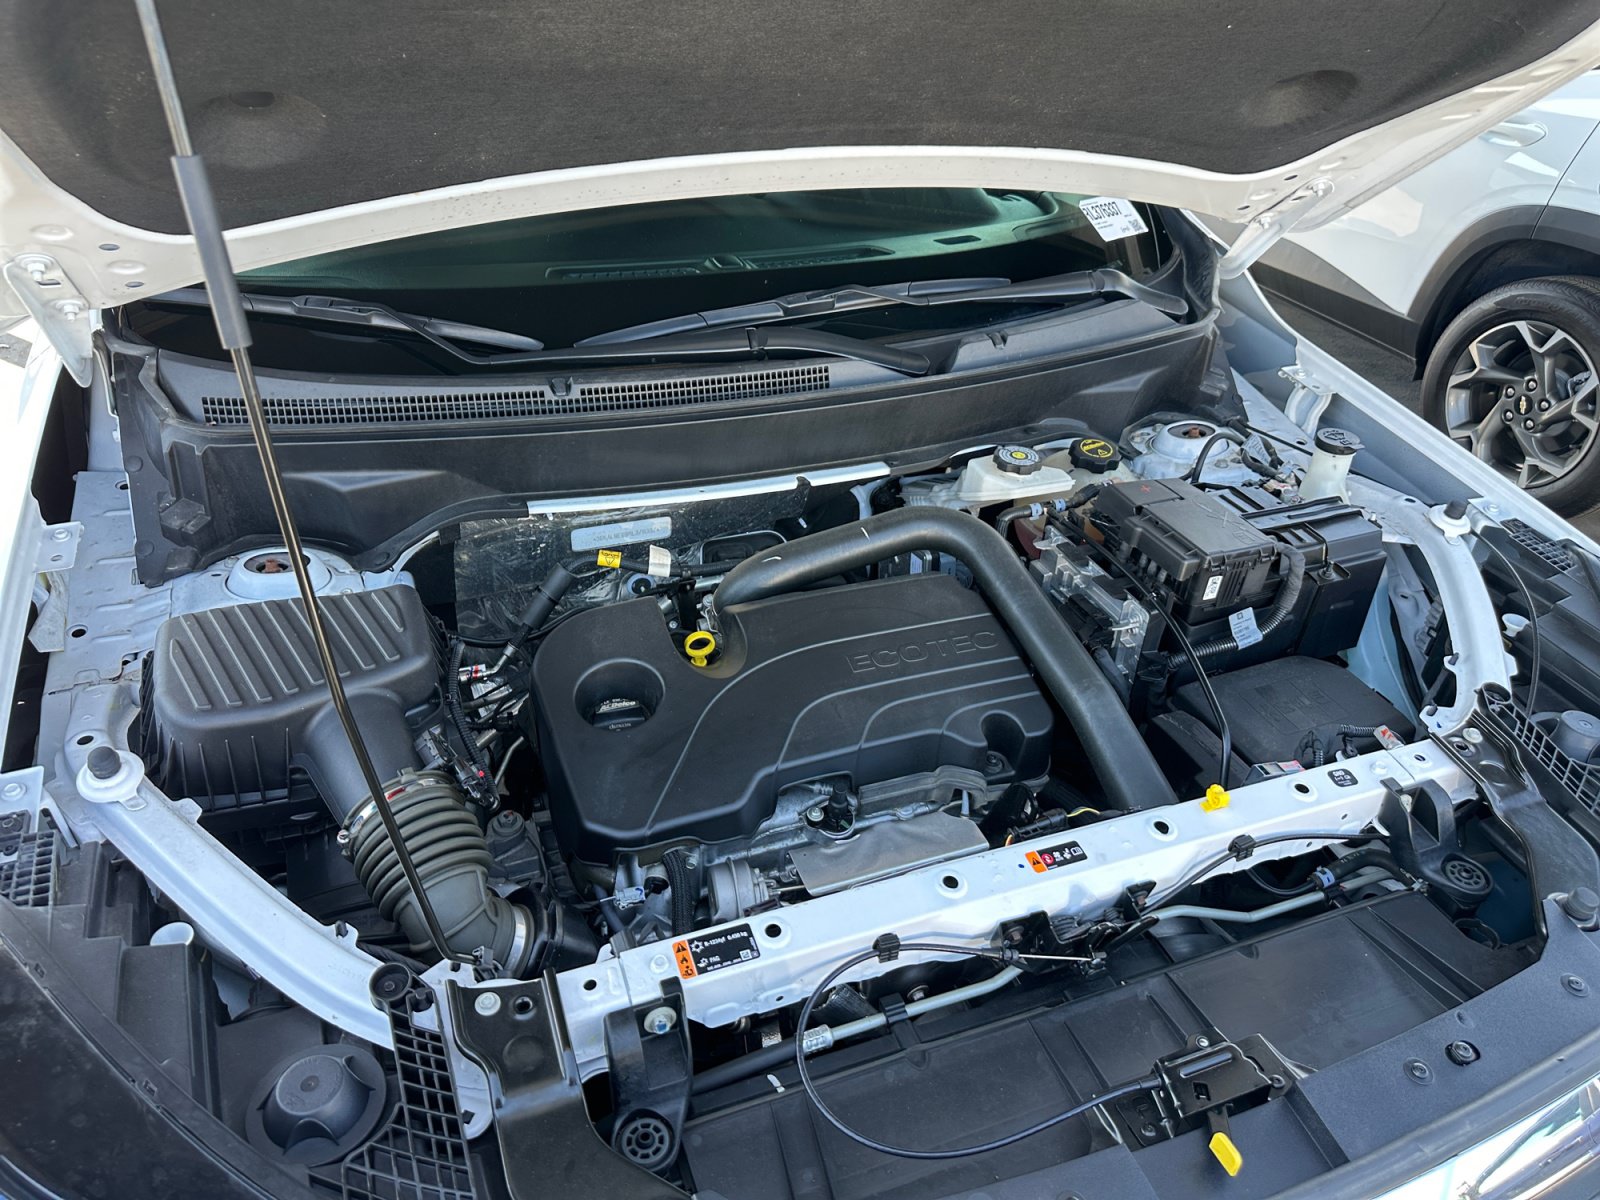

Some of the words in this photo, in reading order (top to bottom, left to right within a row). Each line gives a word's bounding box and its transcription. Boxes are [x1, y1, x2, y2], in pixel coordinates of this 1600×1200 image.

[845, 631, 1000, 673] ECOTEC
[599, 701, 636, 712] ACDelco
[709, 955, 721, 963] PAG
